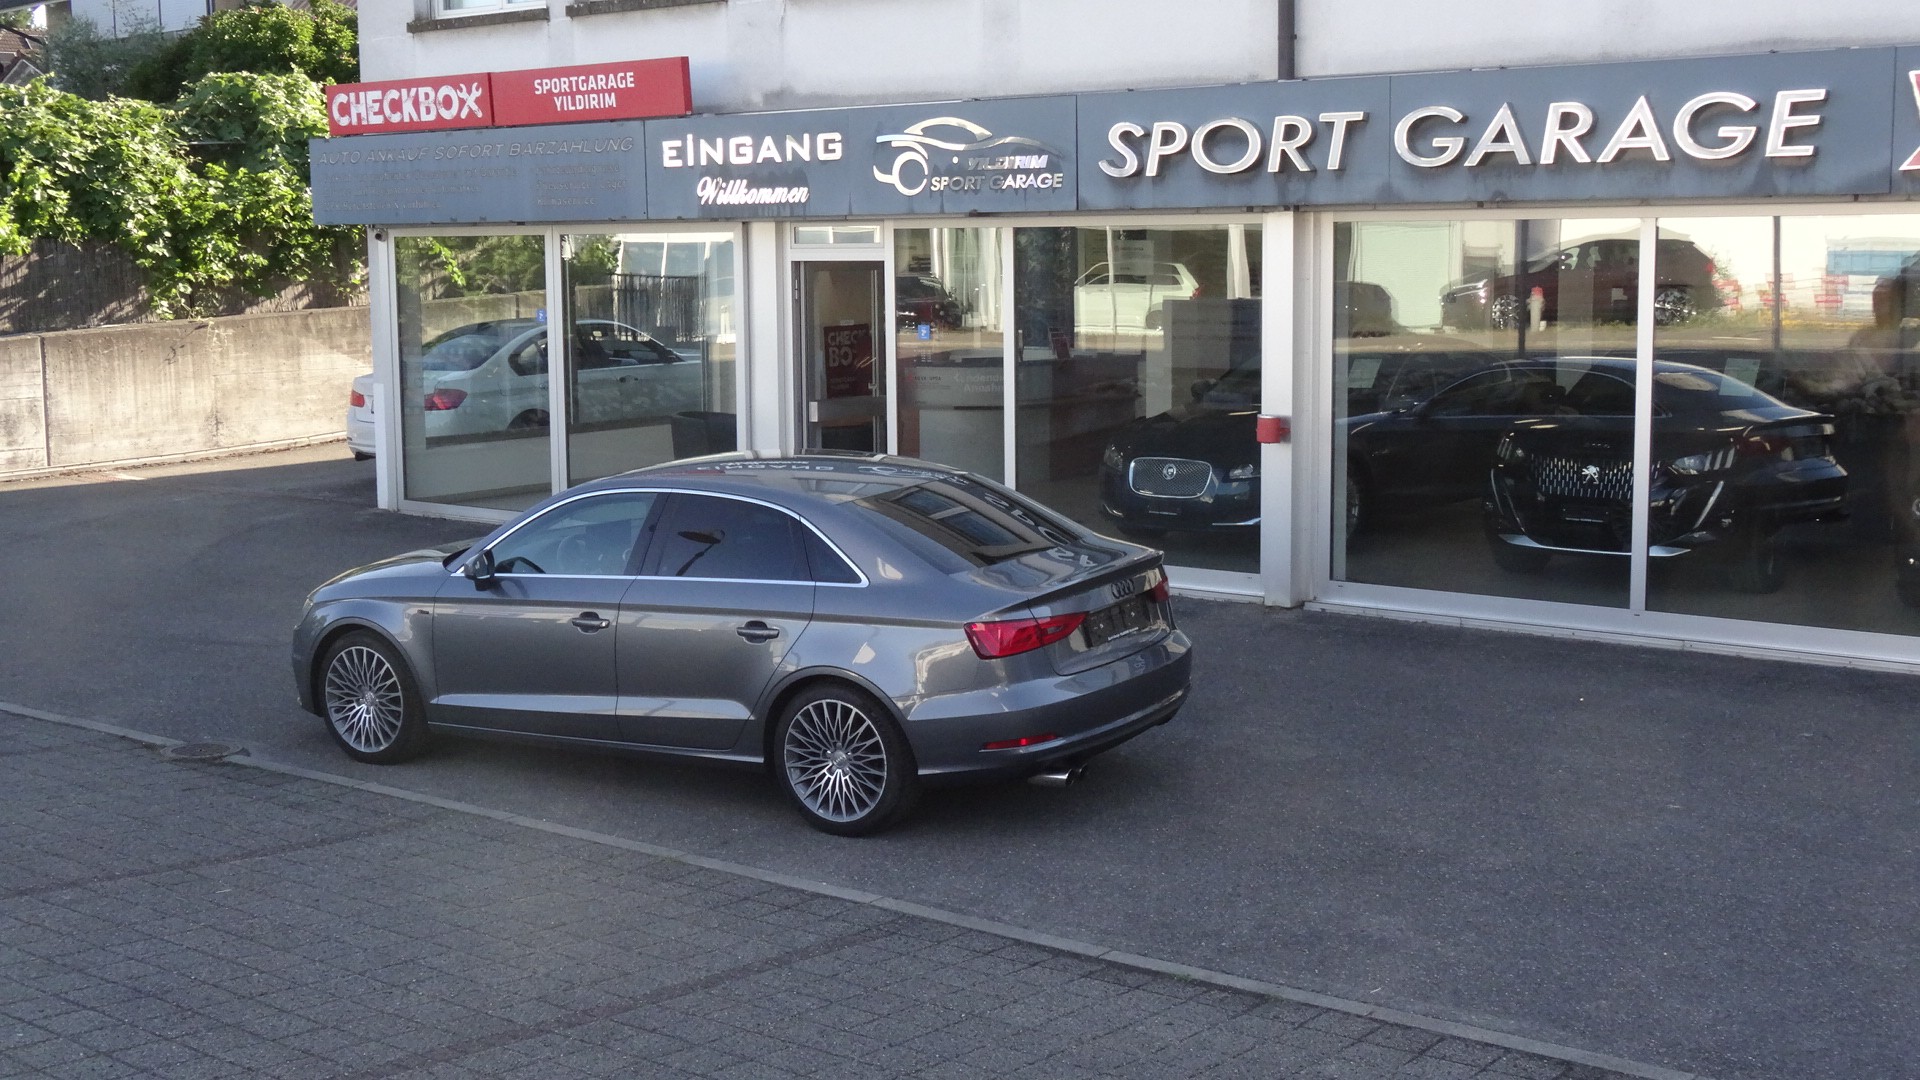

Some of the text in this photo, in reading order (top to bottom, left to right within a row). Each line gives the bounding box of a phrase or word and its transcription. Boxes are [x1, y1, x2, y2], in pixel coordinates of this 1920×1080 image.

[534, 72, 635, 95] SPORTGARAGE
[332, 82, 483, 127] CHECKBOX
[553, 92, 617, 112] YILDIRIM
[1098, 110, 1368, 178] SPORT
[1394, 88, 1828, 168] GARAGE
[319, 137, 634, 165] AUTO ANKAUF SOFORT BARZAHLUNG
[696, 176, 810, 205] Willkommen
[930, 173, 1064, 192] SPORT GARAGE
[829, 346, 857, 367] BO
